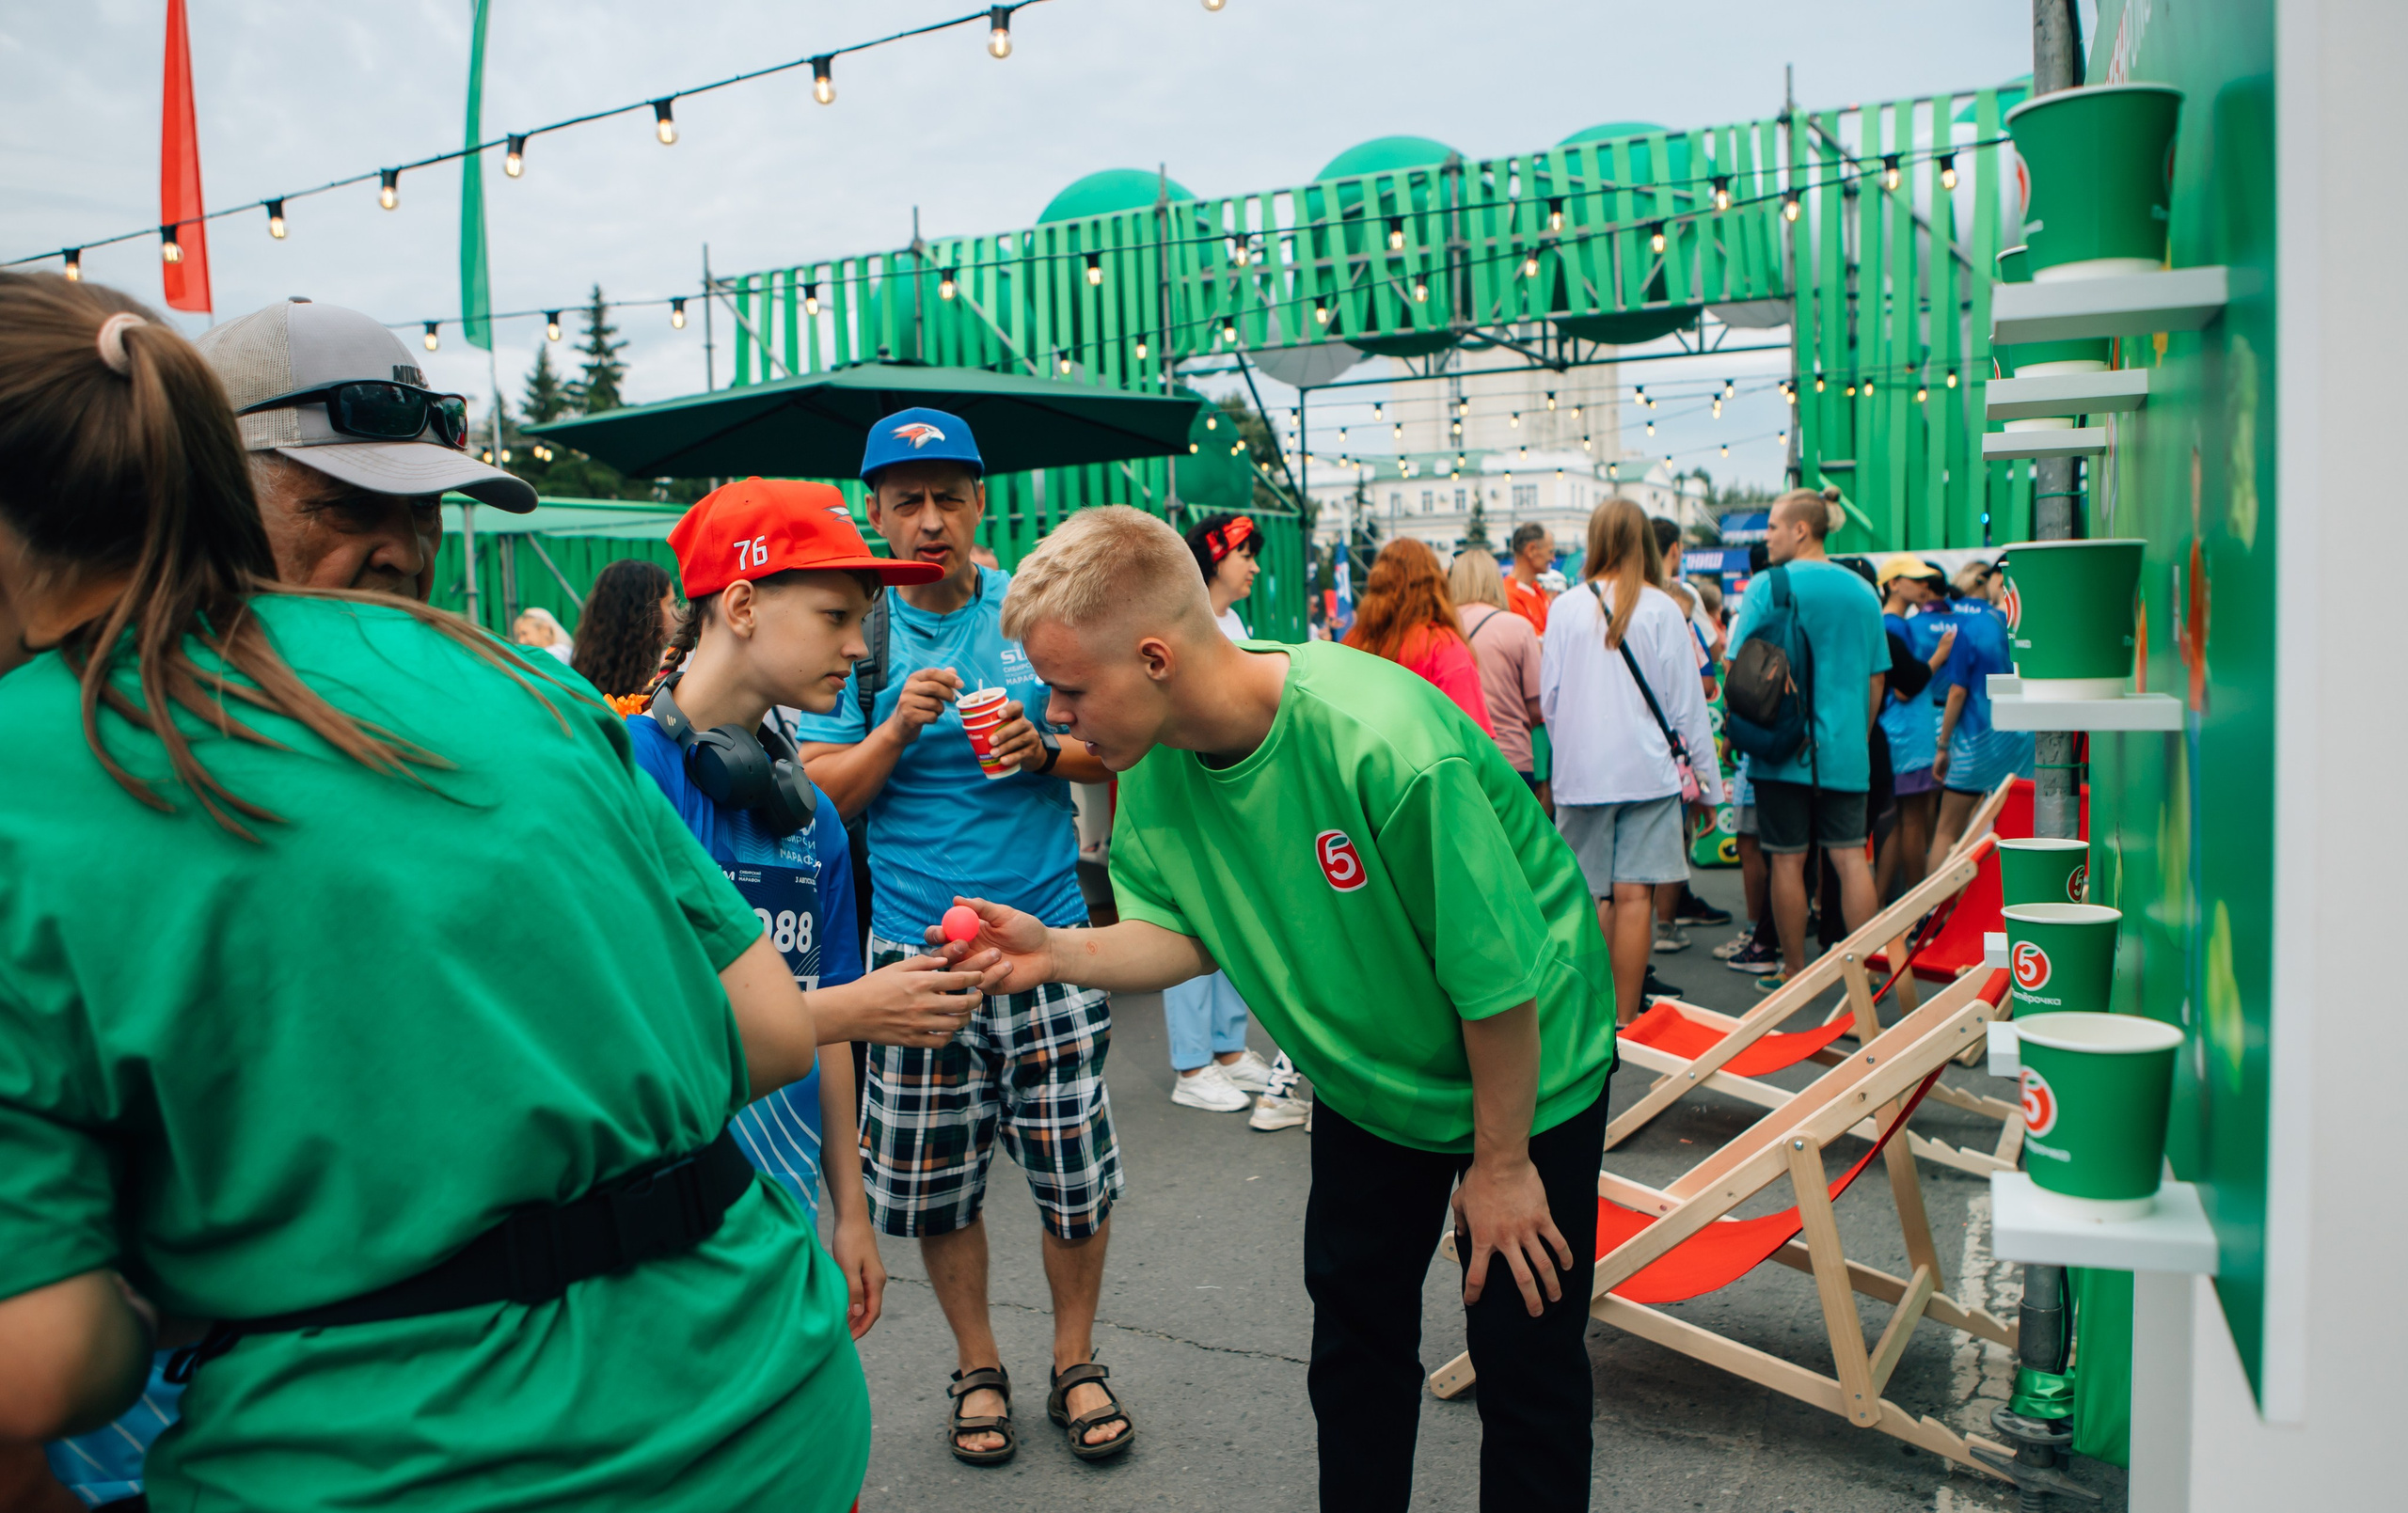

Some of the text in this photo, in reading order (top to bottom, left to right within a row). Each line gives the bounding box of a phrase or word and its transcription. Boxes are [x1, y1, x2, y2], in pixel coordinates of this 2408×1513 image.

[733, 534, 768, 571] 76
[1006, 673, 1036, 686] МАРАФ
[1324, 833, 1356, 881] 5
[2018, 946, 2039, 982] 5
